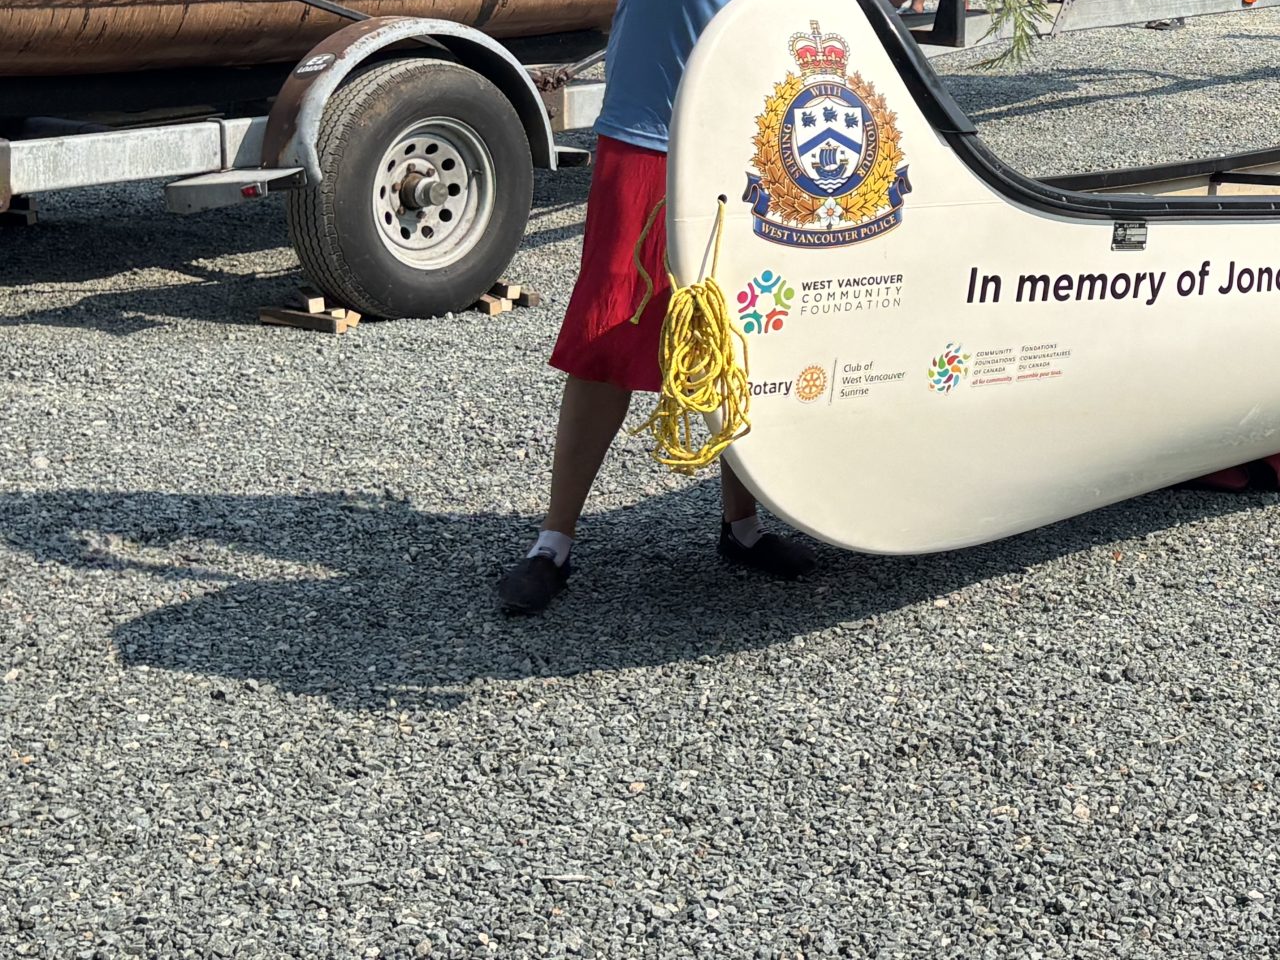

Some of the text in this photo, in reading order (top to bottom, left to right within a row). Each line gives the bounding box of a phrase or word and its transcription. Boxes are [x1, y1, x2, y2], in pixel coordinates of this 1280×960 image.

[809, 84, 842, 97] WITH
[781, 123, 801, 180] SERVING
[855, 121, 878, 177] HONOUR
[761, 215, 897, 244] WEST VANCOUVER POLICE
[801, 274, 904, 292] WEST VANCOUVER
[966, 267, 1003, 303] In
[1015, 270, 1167, 306] memory
[1176, 260, 1211, 298] of
[801, 286, 903, 304] COMMUNITY
[800, 298, 902, 316] FOUNDATION
[976, 349, 1012, 357] COMMUNITY
[843, 361, 875, 373] Club of
[975, 357, 1016, 366] FOUNDATIONS
[1028, 361, 1050, 369] CANADA
[842, 371, 907, 386] West Vancouver
[840, 388, 870, 398] Sunrise
